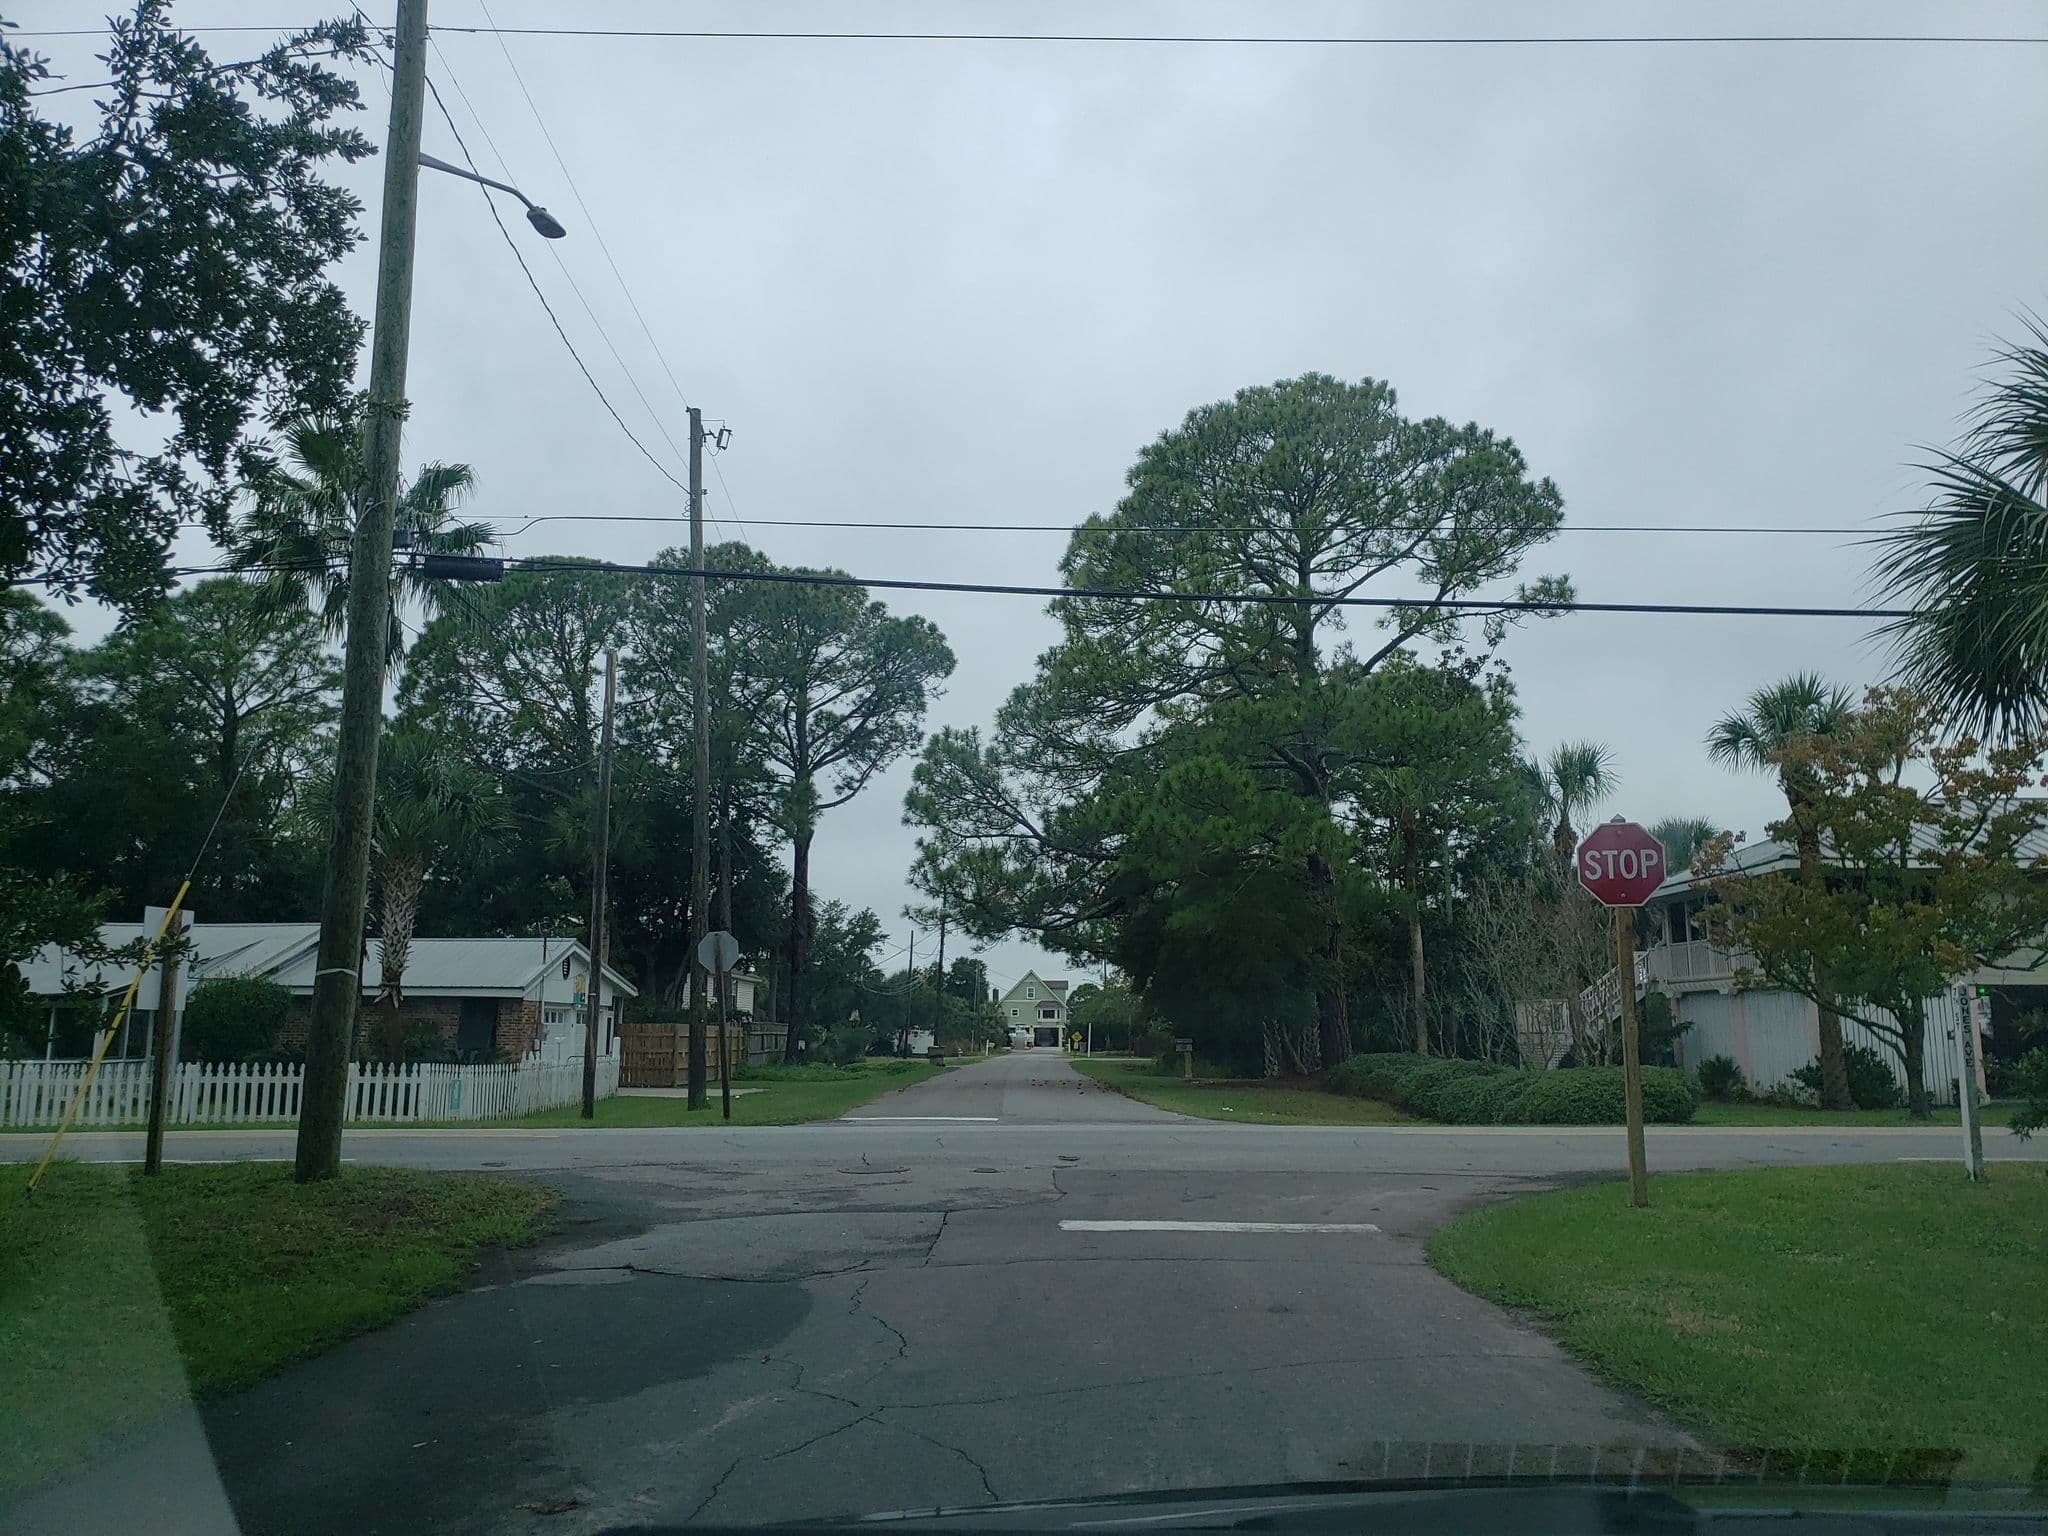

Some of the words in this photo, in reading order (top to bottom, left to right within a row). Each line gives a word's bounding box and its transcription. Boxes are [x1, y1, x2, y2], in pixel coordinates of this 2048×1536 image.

[1584, 849, 1659, 881] STOP
[1961, 987, 1971, 1034] JONES
[1965, 1041, 1973, 1067] AVE
